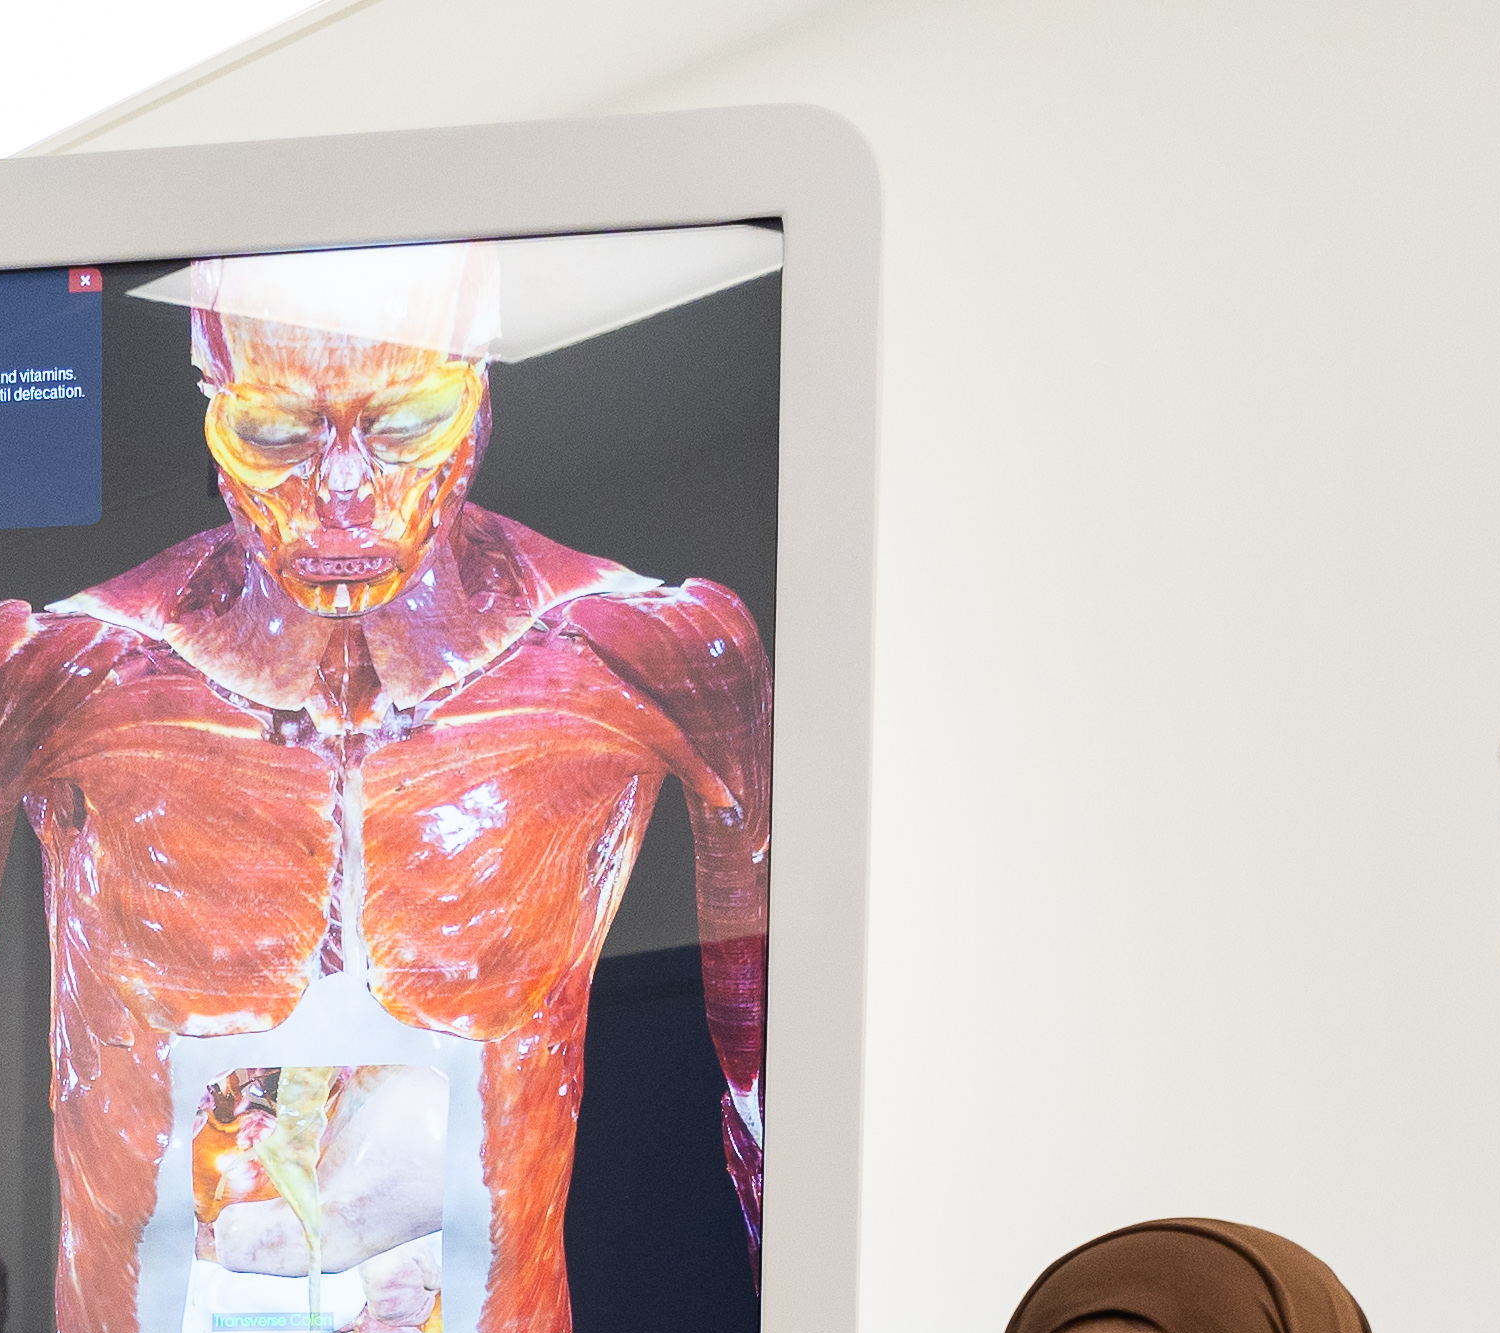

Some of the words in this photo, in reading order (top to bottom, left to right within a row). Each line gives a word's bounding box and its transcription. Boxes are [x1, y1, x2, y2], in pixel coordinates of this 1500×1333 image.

[19, 366, 77, 383] vitamins.
[13, 384, 85, 403] defecation.
[214, 1313, 288, 1328] Transverse
[289, 1312, 333, 1328] Colon
